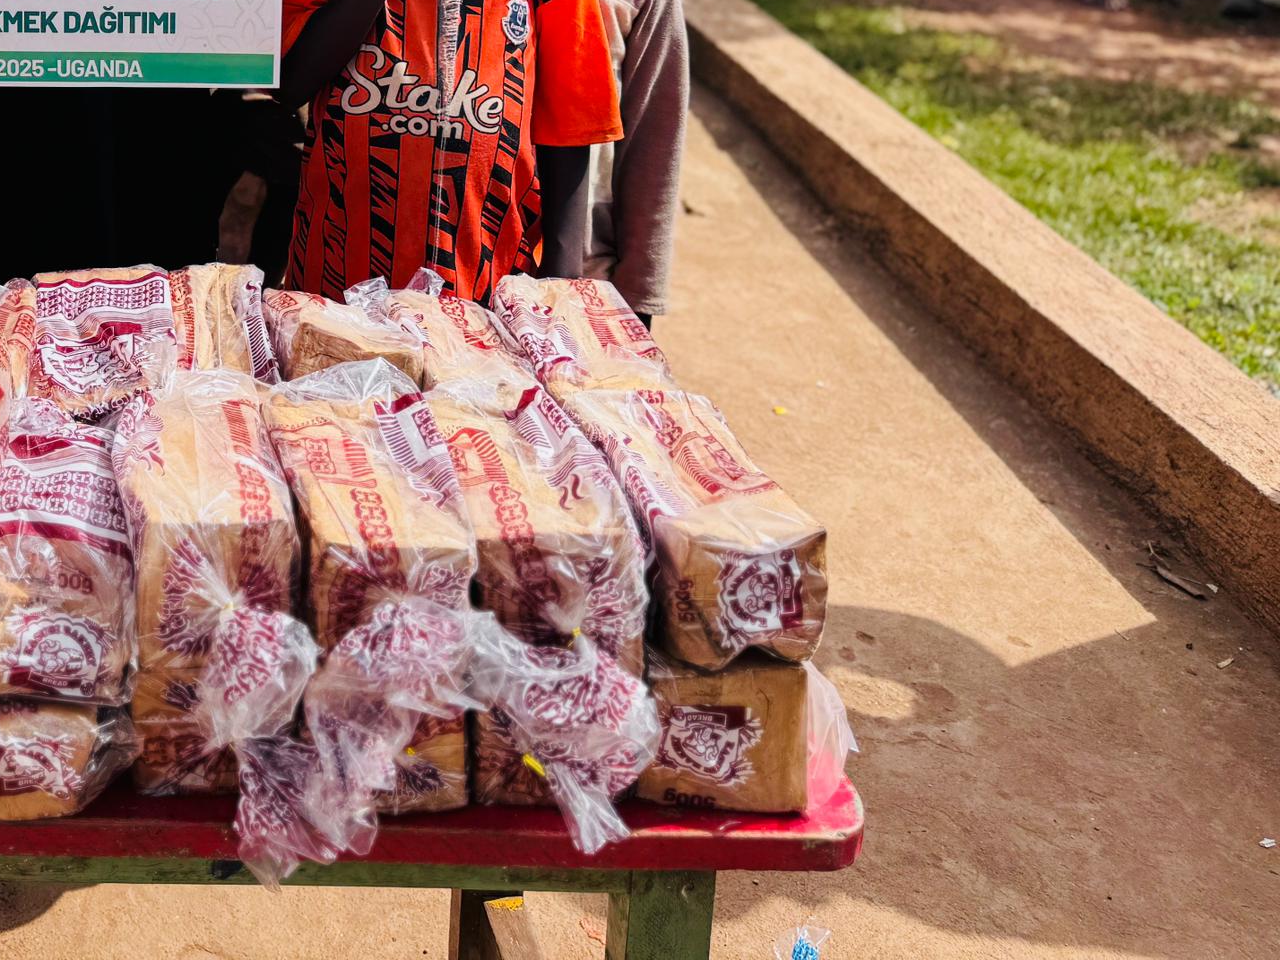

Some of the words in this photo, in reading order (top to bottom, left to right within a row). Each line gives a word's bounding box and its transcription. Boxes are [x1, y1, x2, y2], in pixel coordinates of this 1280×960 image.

[63, 5, 177, 34] DAĞITIMI
[341, 44, 505, 134] Stake
[381, 115, 463, 140] .com
[42, 677, 68, 687] BREAD
